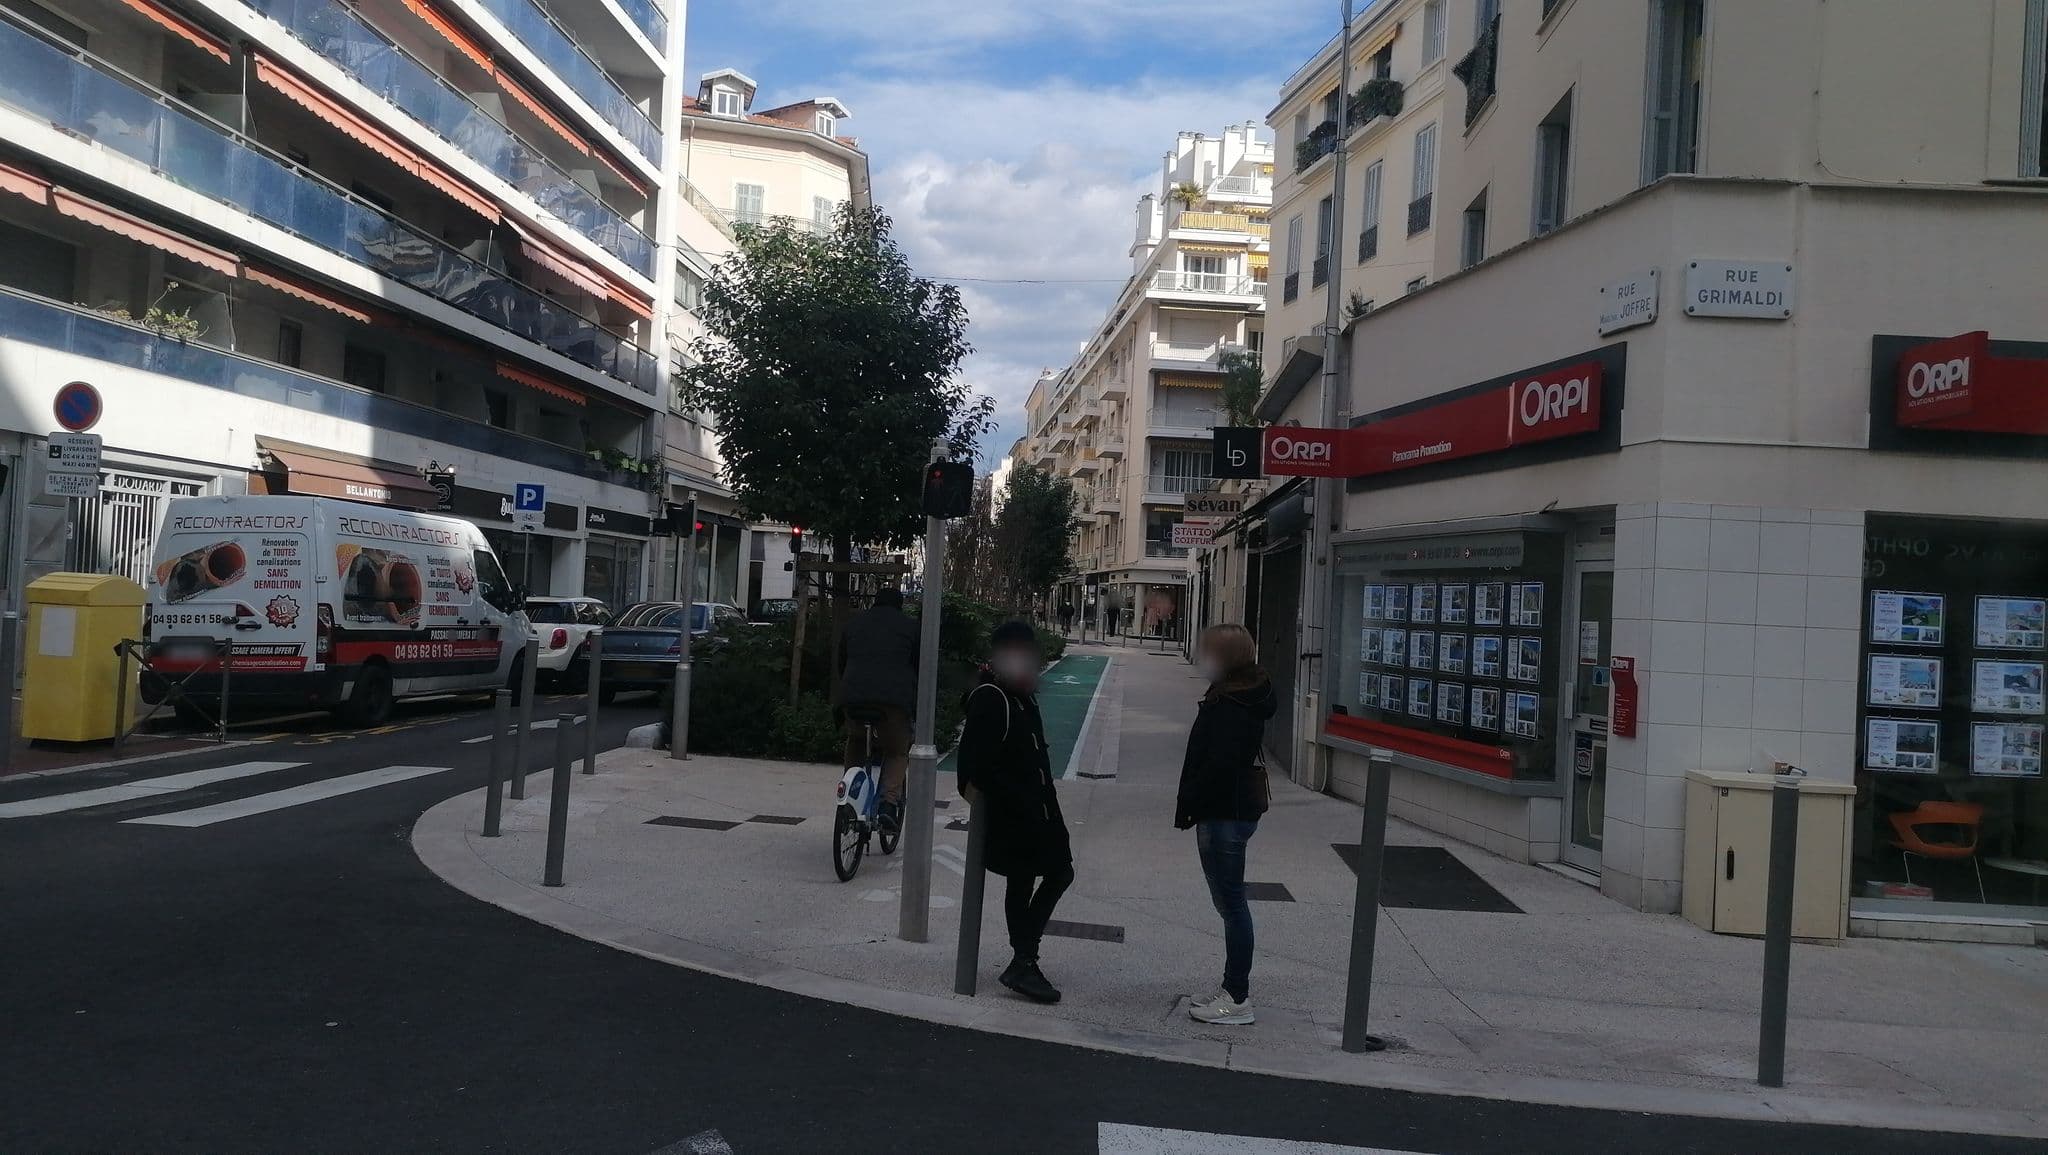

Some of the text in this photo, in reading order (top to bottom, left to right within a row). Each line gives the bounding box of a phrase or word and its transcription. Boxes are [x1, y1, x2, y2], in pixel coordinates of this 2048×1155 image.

[1726, 270, 1758, 282] RUE
[1617, 282, 1636, 299] RUE
[1698, 289, 1783, 306] GRIMALDI
[1619, 297, 1651, 319] JOFFRE
[1907, 357, 1970, 398] ORPI
[1520, 376, 1589, 427] ORPI
[1271, 437, 1331, 460] ORPI
[1392, 441, 1452, 463] Panorama Promotion
[178, 484, 191, 496] VII
[522, 488, 537, 506] P
[1187, 496, 1241, 512] sévan
[174, 516, 309, 529] RCCONTRACTORS
[338, 517, 460, 545] RCCONTRACTORS
[1174, 527, 1218, 537] STATION
[1174, 537, 1217, 545] COIFFURE
[262, 549, 297, 557] de TOUTES
[267, 568, 289, 577] SANS
[253, 579, 302, 589] DEMOLITION
[153, 614, 221, 624] 04 93 62 61 58
[274, 646, 296, 655] OFFERT
[394, 645, 406, 659] 04
[419, 644, 431, 658] 62
[431, 644, 442, 658] 61
